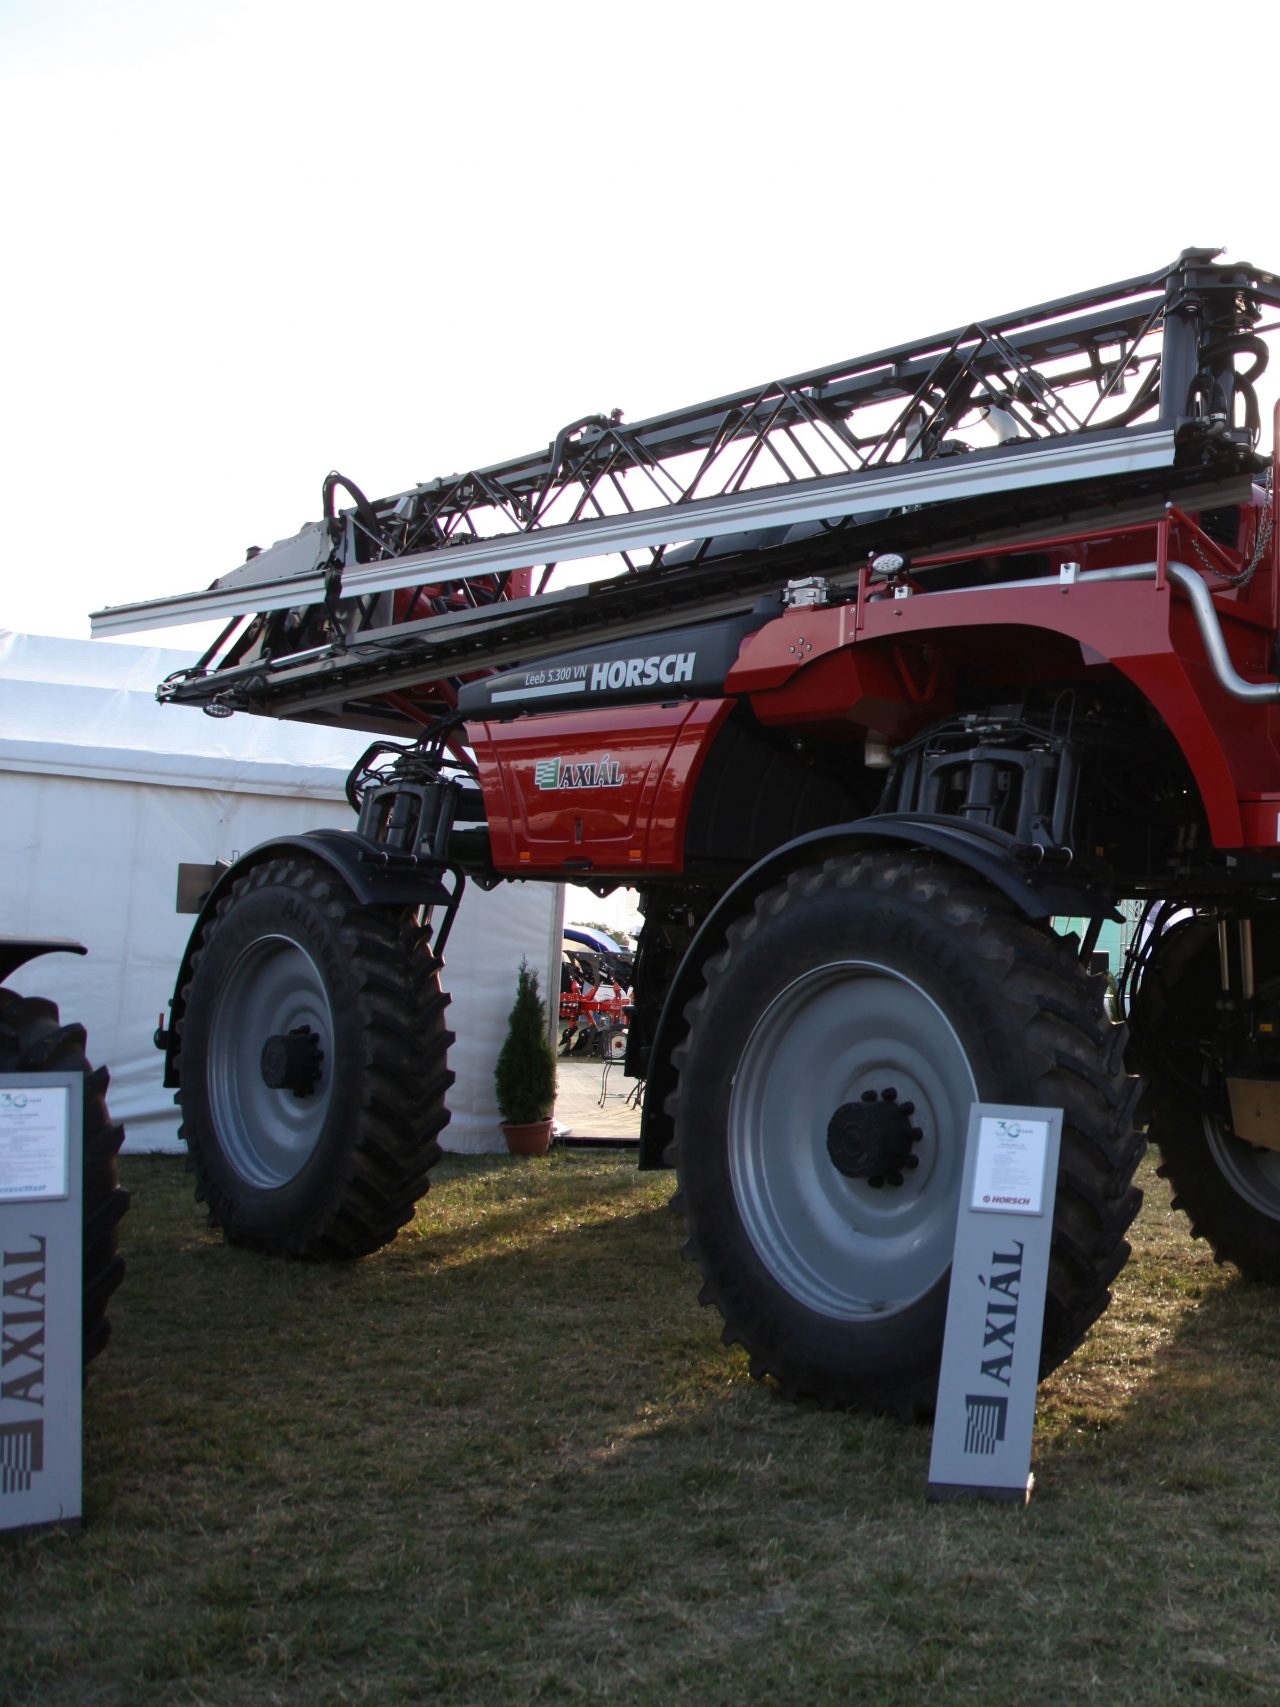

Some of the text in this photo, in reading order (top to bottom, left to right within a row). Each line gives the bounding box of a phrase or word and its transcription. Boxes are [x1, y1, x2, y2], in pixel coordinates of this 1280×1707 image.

[525, 652, 696, 691] Leeb 5.300 VN HORSCH
[559, 753, 624, 787] AXIÁL
[992, 1195, 1031, 1206] HORSCH
[977, 1239, 1025, 1389] AXIÁL
